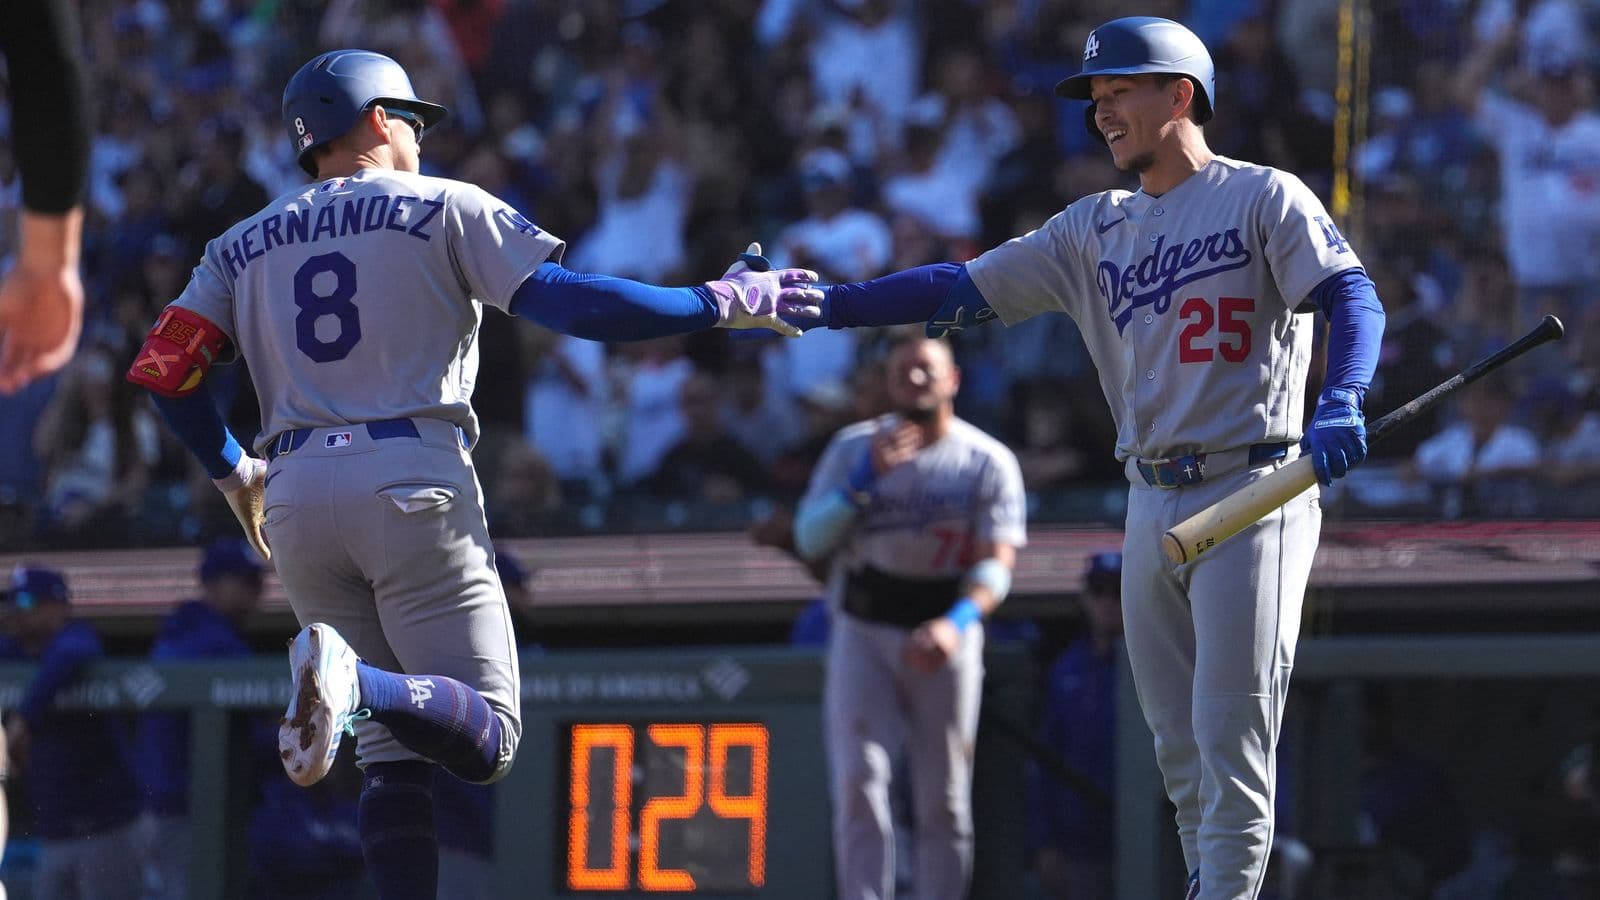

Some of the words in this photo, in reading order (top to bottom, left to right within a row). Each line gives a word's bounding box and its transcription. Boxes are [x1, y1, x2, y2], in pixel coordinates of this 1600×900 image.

[1084, 29, 1100, 61] LA
[294, 117, 305, 135] 8
[221, 189, 447, 280] HERNÁNDEZ
[1313, 215, 1349, 254] LA
[293, 251, 362, 363] 8
[1096, 228, 1252, 338] Dodgers
[1179, 296, 1256, 364] 25
[405, 677, 436, 709] LA
